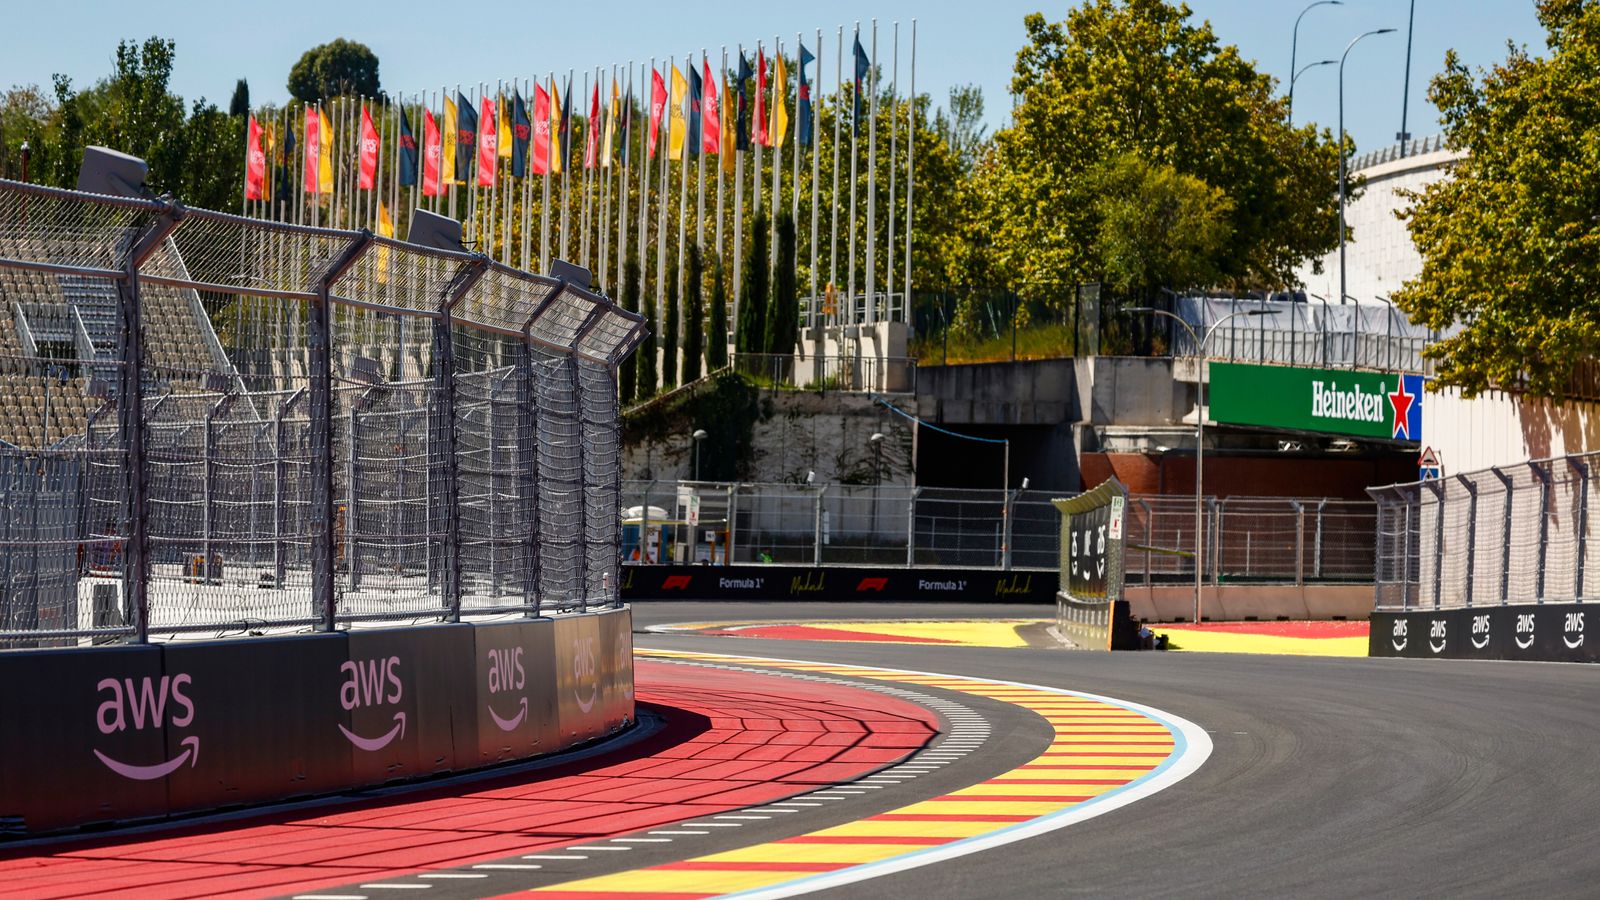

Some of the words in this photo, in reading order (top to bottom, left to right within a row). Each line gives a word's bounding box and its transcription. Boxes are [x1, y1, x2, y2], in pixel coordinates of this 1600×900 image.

[1312, 381, 1385, 423] Heineken
[719, 577, 754, 589] Formula
[919, 579, 956, 591] Formula
[1393, 619, 1408, 637] aws
[1430, 619, 1447, 638] aws
[1472, 614, 1490, 634] aws
[1516, 613, 1535, 633] aws
[1565, 612, 1585, 632] aws
[574, 637, 595, 678] aws
[487, 646, 526, 694] aws
[340, 655, 402, 711] aws
[96, 672, 195, 734] aws
